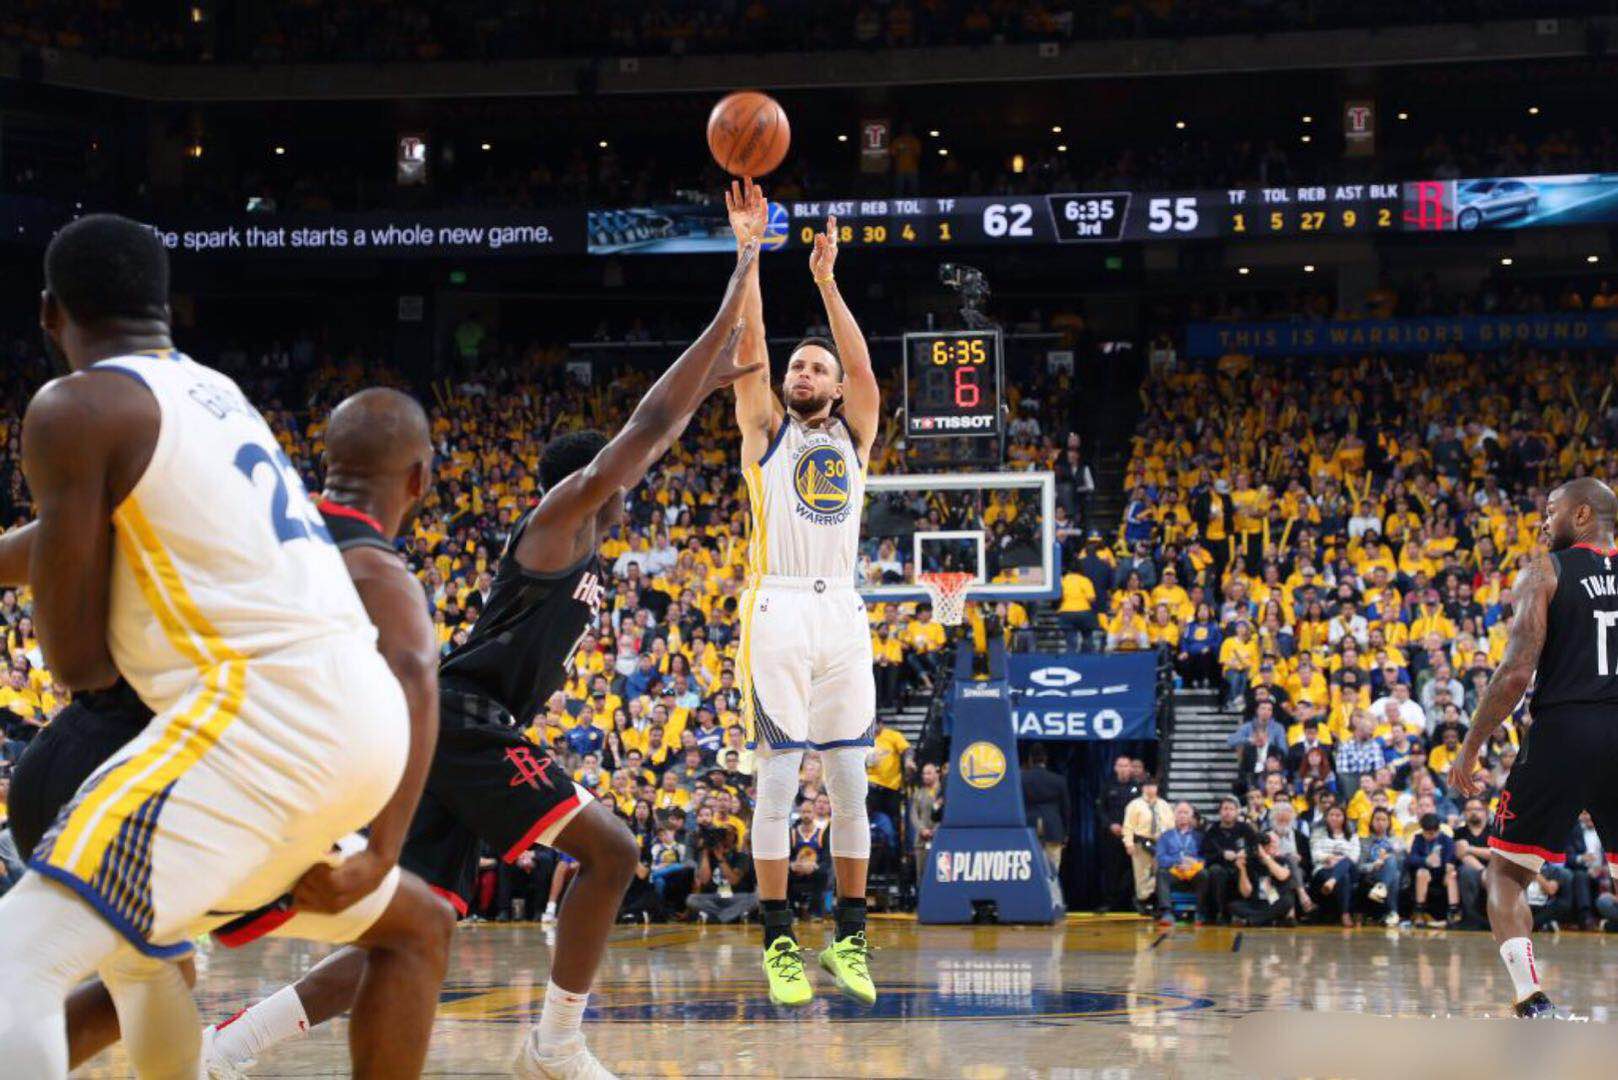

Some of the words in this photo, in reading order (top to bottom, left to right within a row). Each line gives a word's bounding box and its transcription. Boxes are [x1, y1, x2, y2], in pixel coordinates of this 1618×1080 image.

[1229, 190, 1246, 203] TF
[1263, 188, 1289, 202] TOL
[1298, 187, 1326, 201] REB
[1335, 186, 1362, 199] AST
[1370, 184, 1398, 198] BLK
[794, 204, 820, 217] BLK
[828, 202, 854, 215] AST
[861, 201, 887, 214] REB
[895, 200, 921, 214] TOL
[938, 199, 954, 212] TF
[1064, 200, 1114, 221] 6:35
[1148, 197, 1198, 232] 55
[982, 203, 1033, 237] 62
[1077, 221, 1101, 236] 3rd
[1233, 215, 1245, 232] 1
[1270, 213, 1284, 230] 5
[1301, 212, 1325, 230] 27
[1343, 210, 1356, 227] 9
[1378, 209, 1391, 226] 2
[141, 224, 178, 248] he
[184, 226, 241, 252] spark
[246, 225, 285, 247] that
[291, 226, 348, 247] starts
[354, 229, 366, 246] a
[371, 224, 434, 246] whole
[439, 227, 483, 244] new
[488, 225, 553, 249] game.
[863, 225, 887, 243] 30
[902, 223, 916, 241] 4
[939, 222, 951, 241] 1
[1218, 329, 1277, 349] THIS
[1291, 329, 1315, 347] IS
[1330, 325, 1463, 346] WARRIORS
[1479, 322, 1588, 342] GROUND
[932, 339, 986, 365] 6:35
[955, 366, 980, 408] 6
[934, 415, 994, 429] TISSOT
[823, 459, 846, 478] 30
[953, 850, 1032, 881] PLAYOFFS
